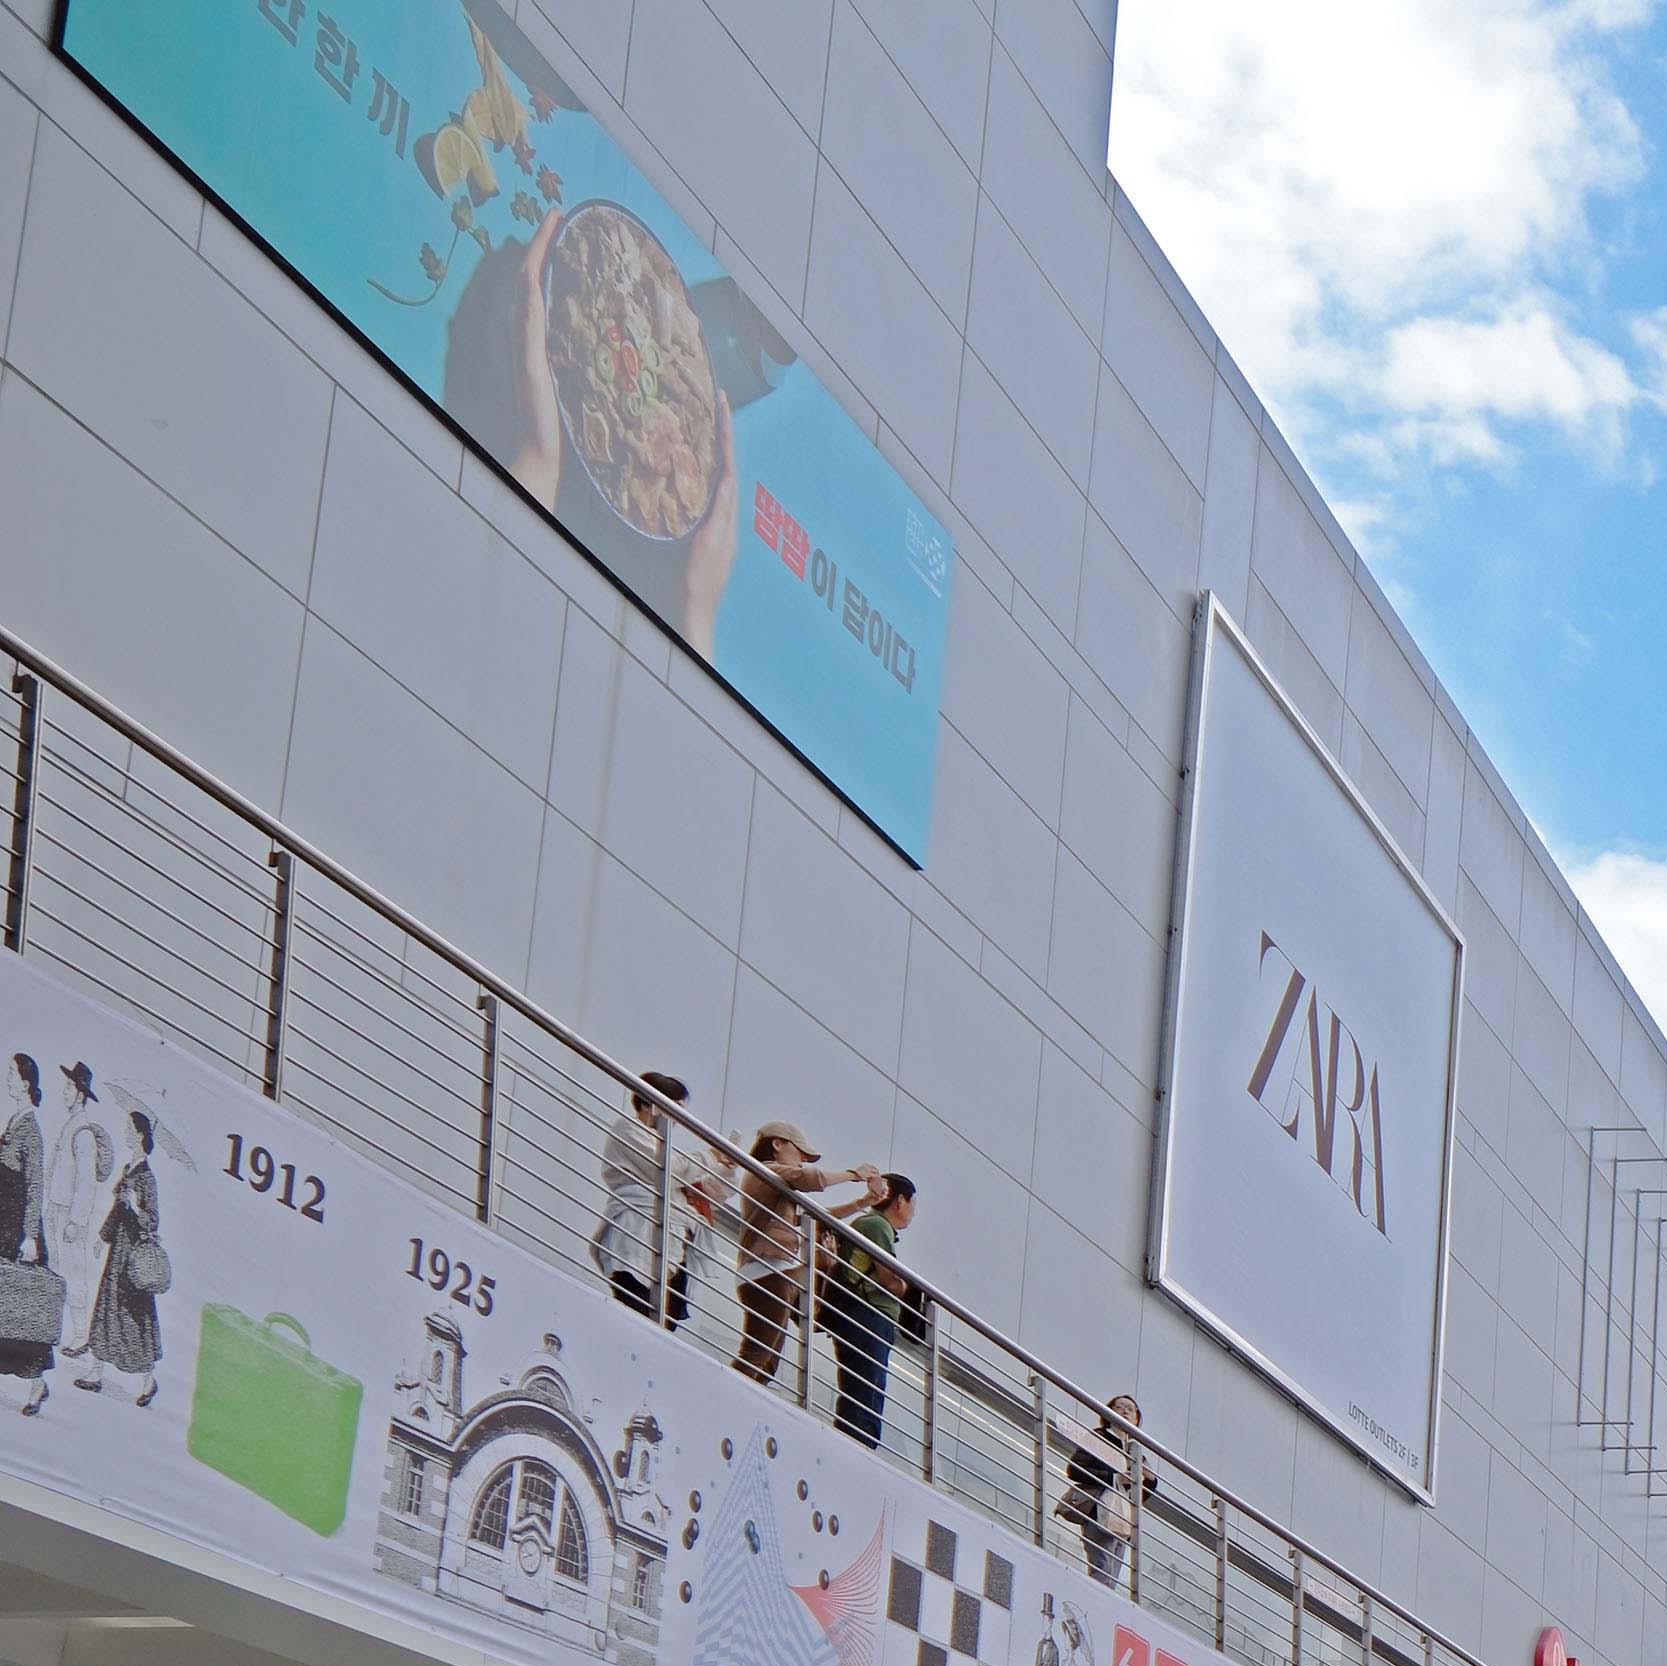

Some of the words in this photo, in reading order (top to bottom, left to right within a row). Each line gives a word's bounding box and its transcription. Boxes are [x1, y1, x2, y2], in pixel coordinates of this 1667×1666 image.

[314, 9, 360, 104] 한
[367, 65, 410, 160] 끼
[842, 576, 916, 695] 답이다
[1246, 929, 1390, 1241] ZARA
[223, 1133, 327, 1224] 1912
[407, 1237, 497, 1317] 1925
[1348, 1400, 1369, 1430] LOTTE
[1370, 1420, 1398, 1454] OUTLETS
